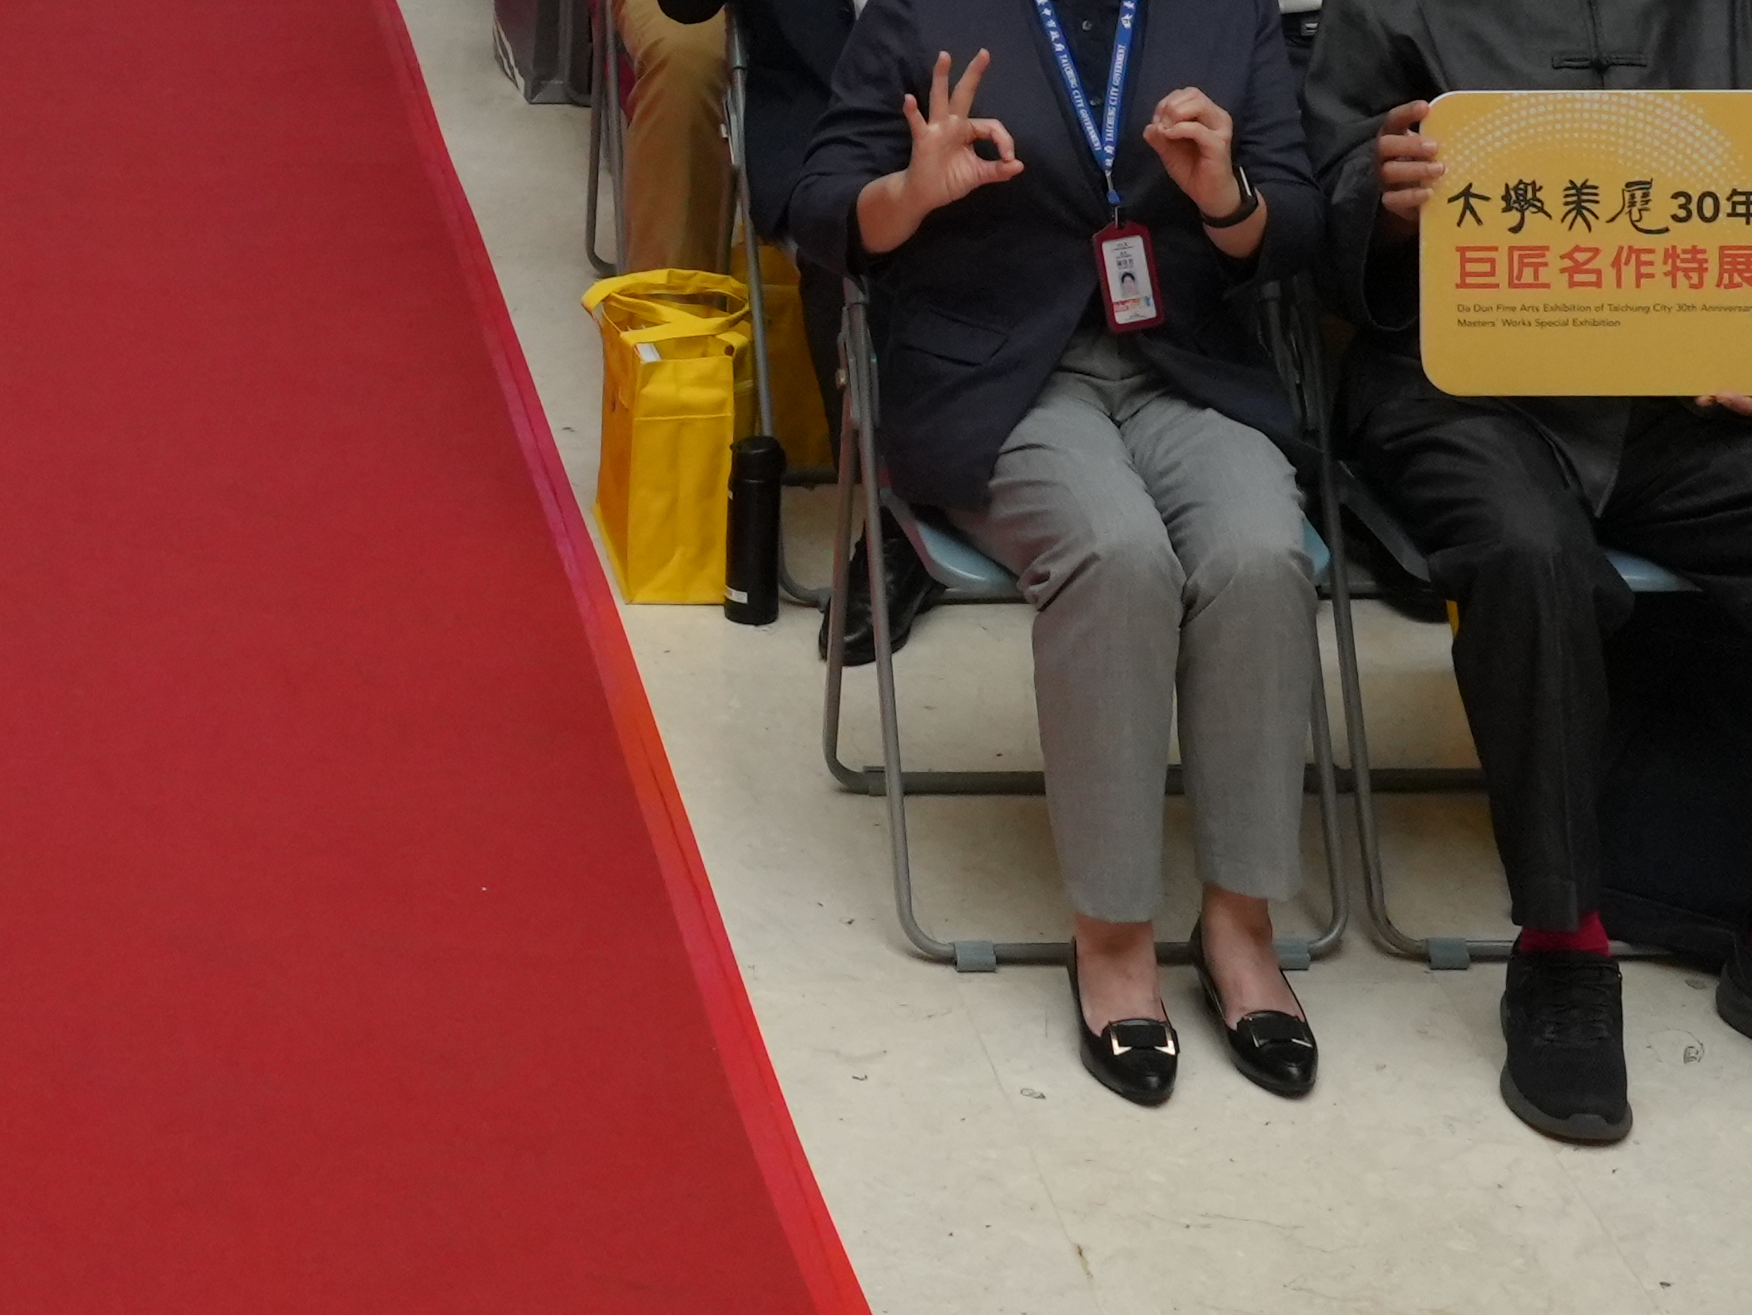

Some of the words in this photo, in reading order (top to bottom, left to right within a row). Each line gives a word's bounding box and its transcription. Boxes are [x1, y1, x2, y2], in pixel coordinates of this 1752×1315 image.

[1457, 303, 1472, 313] Da
[1473, 303, 1494, 313] Dun
[1496, 303, 1517, 313] Fine
[1520, 303, 1540, 313] Arts
[1543, 303, 1592, 313] Exhibition
[1594, 303, 1605, 313] of
[1607, 303, 1651, 315] Taichung
[1653, 303, 1673, 315] City
[1676, 303, 1697, 313] 30th
[1501, 317, 1533, 328] Works
[1534, 317, 1570, 330] Special
[1572, 317, 1622, 328] Exhibition
